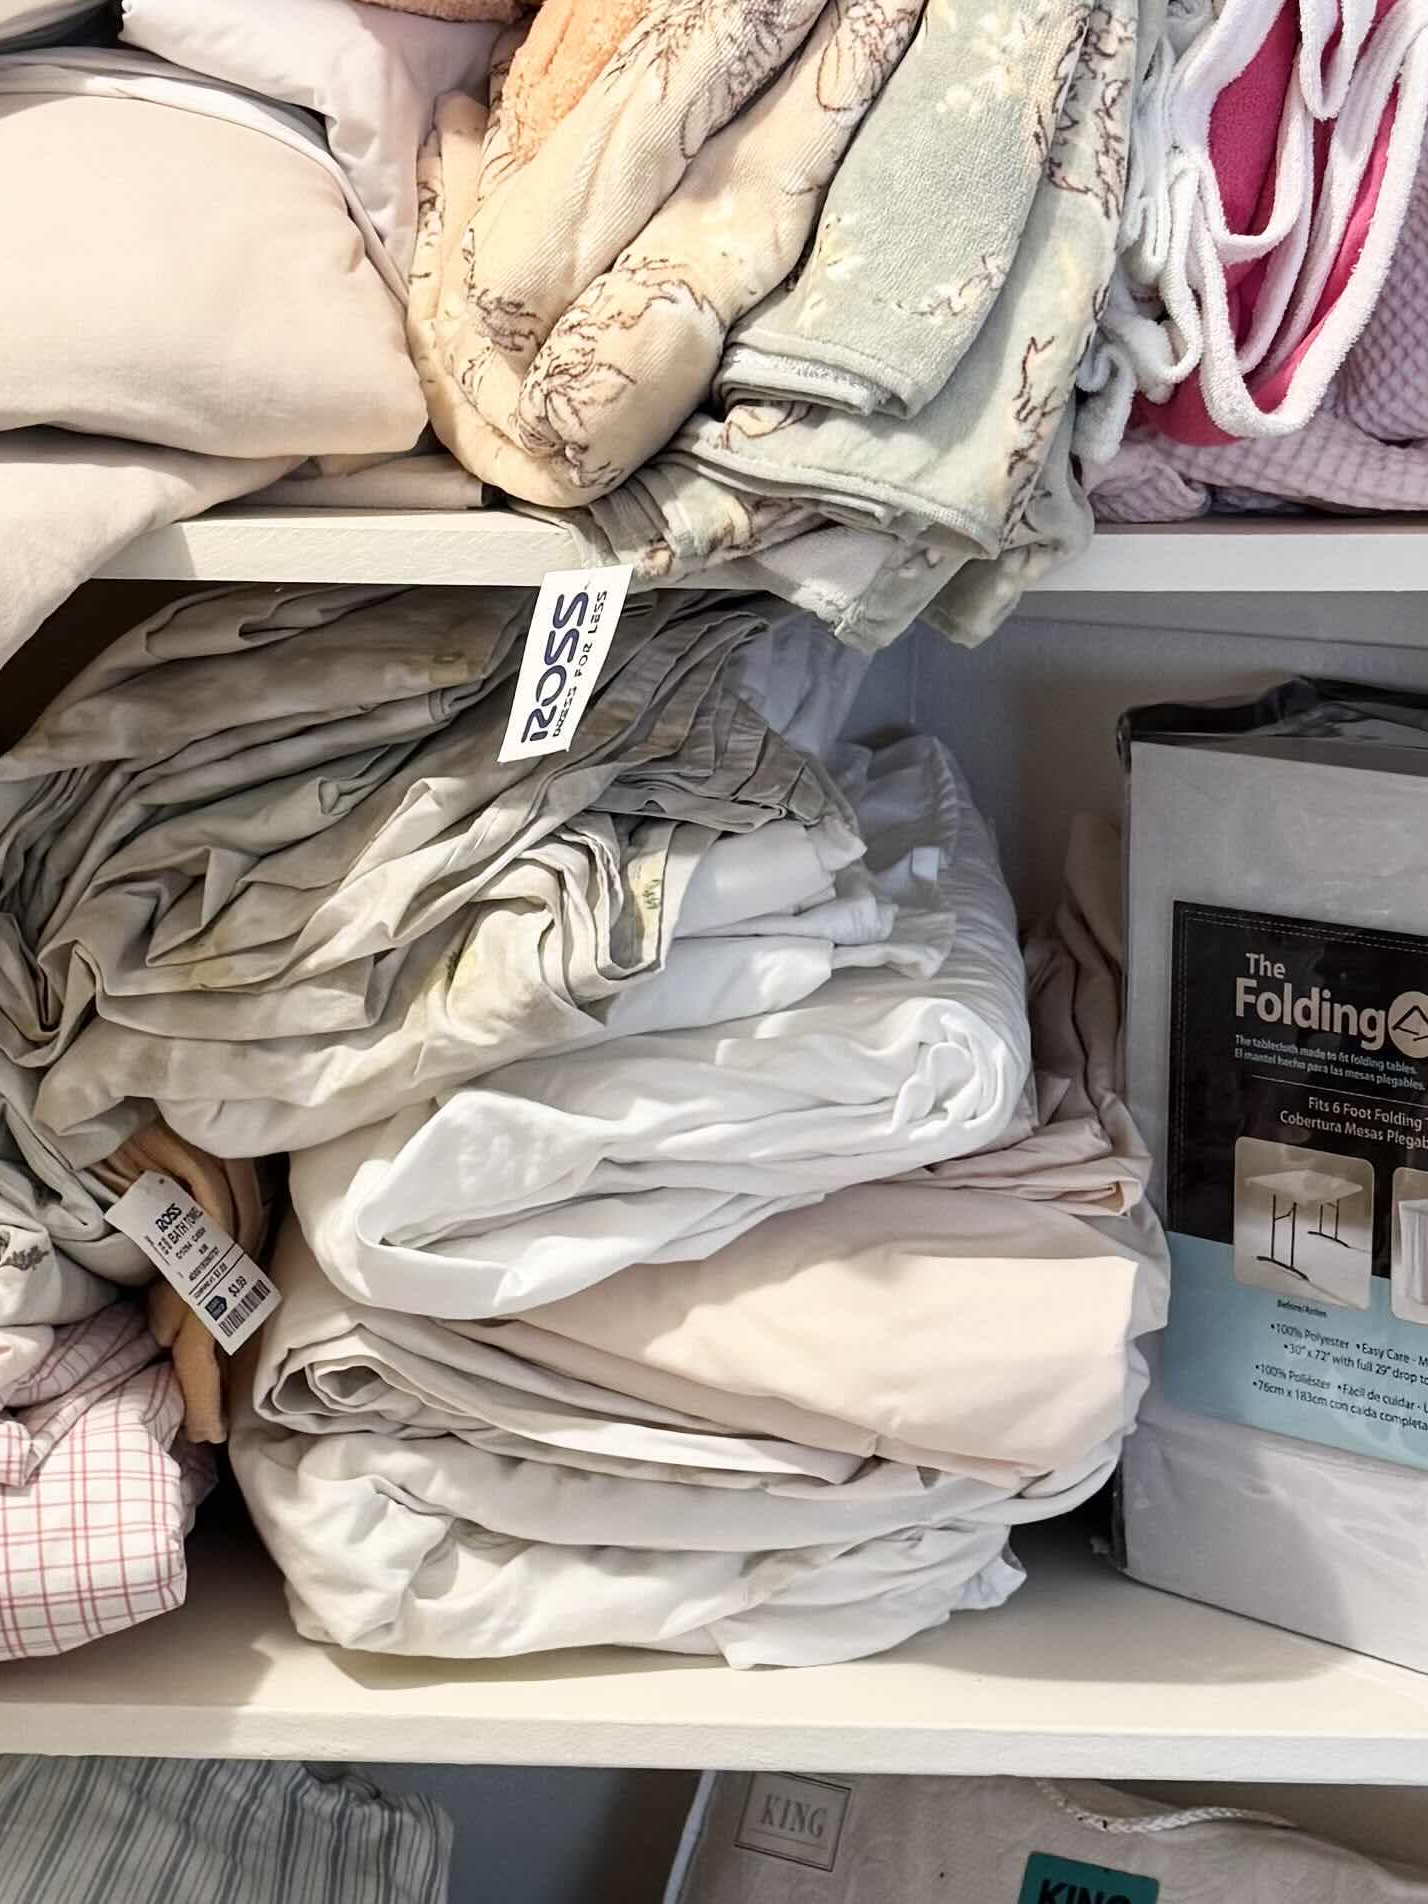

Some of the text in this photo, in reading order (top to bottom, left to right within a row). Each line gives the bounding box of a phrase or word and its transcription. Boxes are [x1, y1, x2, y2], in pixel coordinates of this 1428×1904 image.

[520, 590, 589, 744] ROSS
[552, 590, 608, 738] DRESS FOR LESS
[1245, 953, 1285, 980] The
[1234, 976, 1386, 1051] Folding
[1350, 1052, 1384, 1072] folding
[1280, 1110, 1342, 1134] Cobertura
[1344, 1122, 1384, 1141] Mesas
[1308, 1096, 1329, 1112] Fits
[1332, 1102, 1341, 1114] 6
[1343, 1103, 1372, 1120] Foot
[1374, 1109, 1422, 1131] Folding
[155, 1203, 183, 1233] ROSS
[1304, 1329, 1349, 1350] Polyester
[1361, 1342, 1385, 1360] Easy
[1386, 1348, 1410, 1364] Care
[1332, 1355, 1355, 1369] with
[1356, 1358, 1373, 1372] full
[1392, 1368, 1418, 1384] drop
[1258, 1379, 1285, 1396] 76cm
[1295, 1389, 1328, 1407] 183cm
[1379, 1410, 1428, 1431] completa
[1382, 1393, 1416, 1411] cuidar
[760, 1793, 828, 1839] KING
